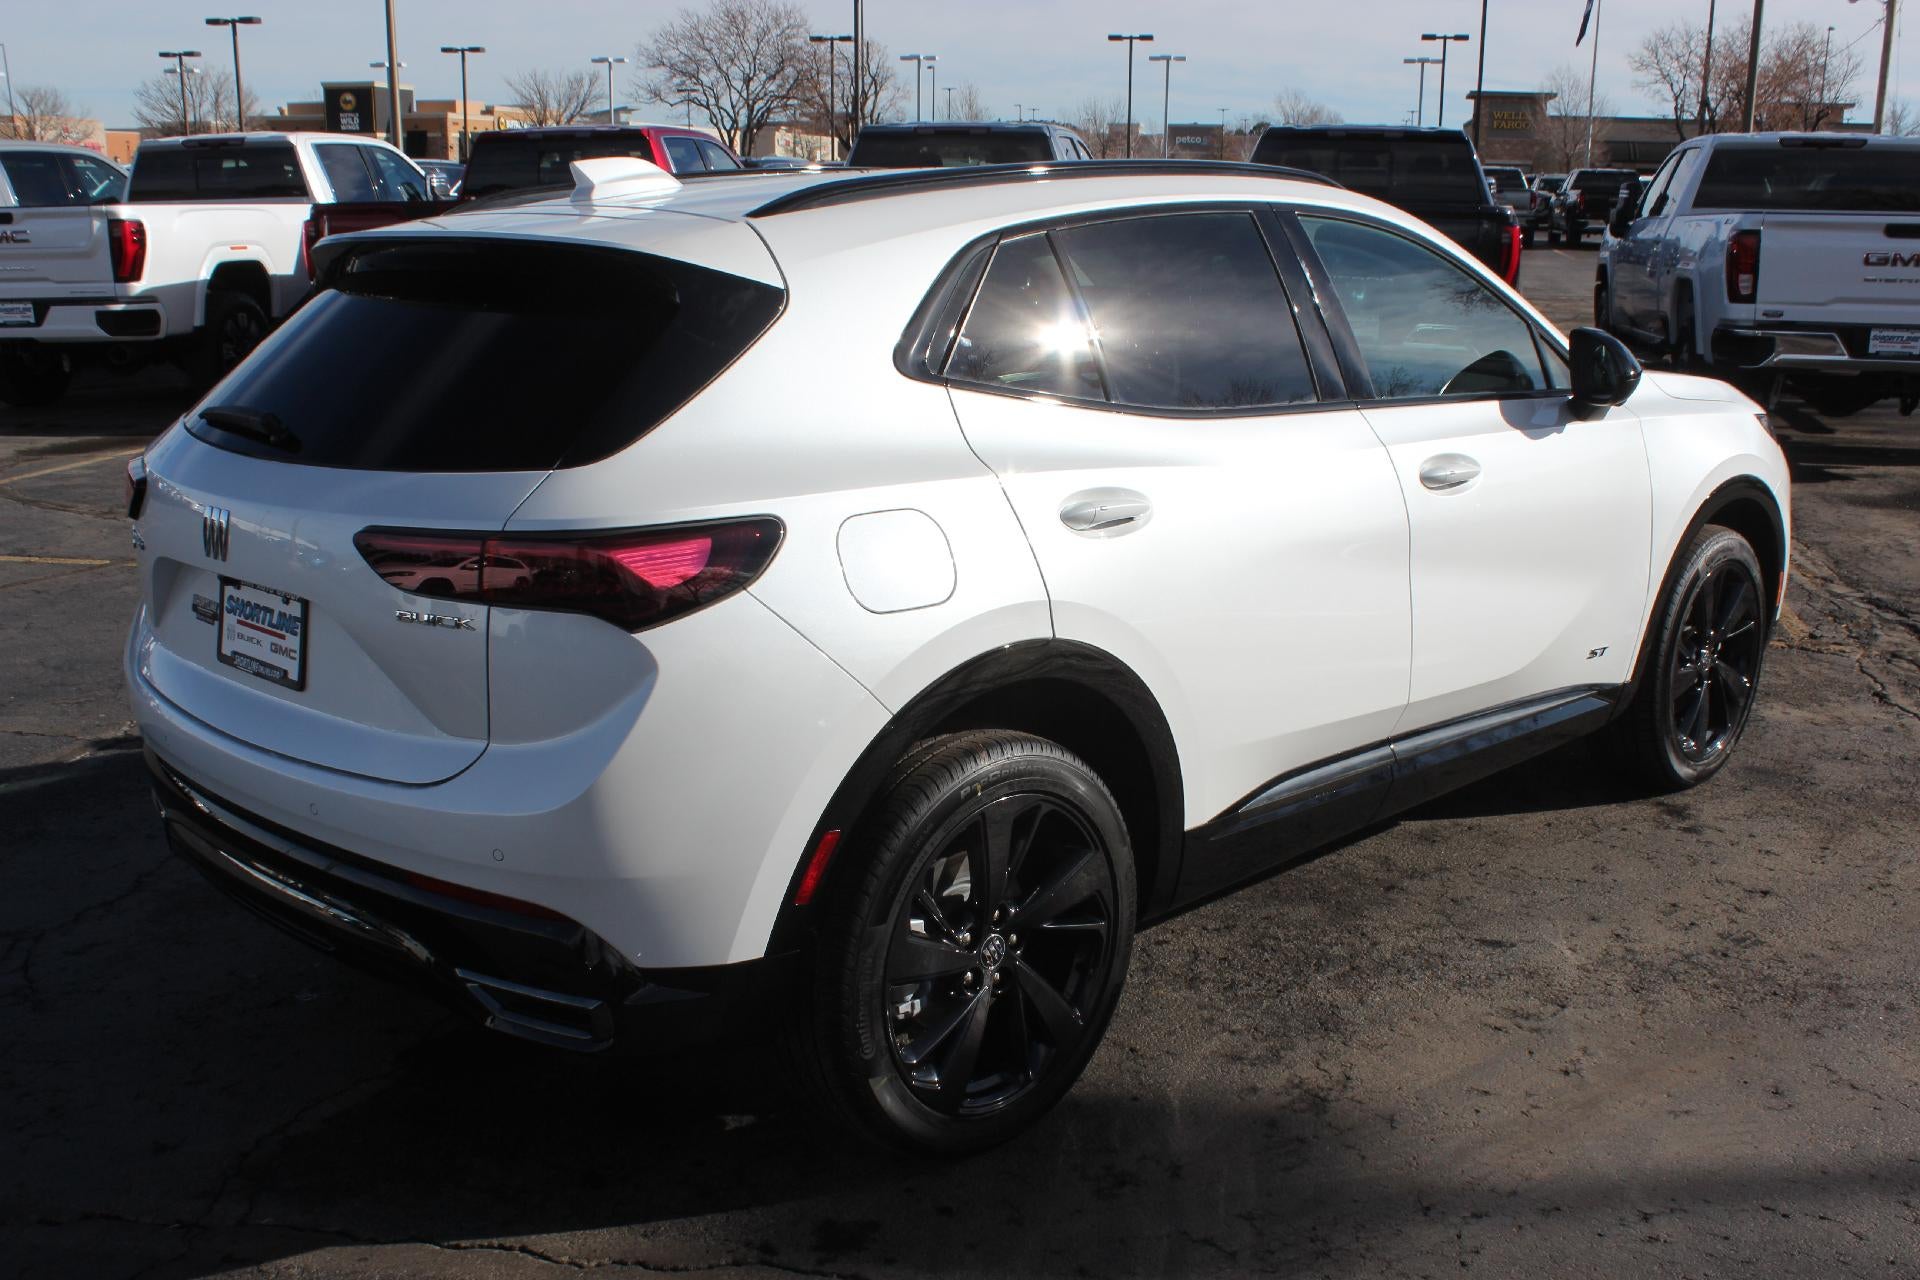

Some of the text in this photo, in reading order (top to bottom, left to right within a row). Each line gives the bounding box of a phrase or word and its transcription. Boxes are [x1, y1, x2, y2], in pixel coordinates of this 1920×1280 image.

[1176, 136, 1202, 145] petco
[226, 594, 299, 636] SHORTLINE
[396, 610, 477, 631] BUICK
[237, 632, 263, 647] BUICK
[270, 642, 298, 661] GMC
[1586, 646, 1609, 660] ST
